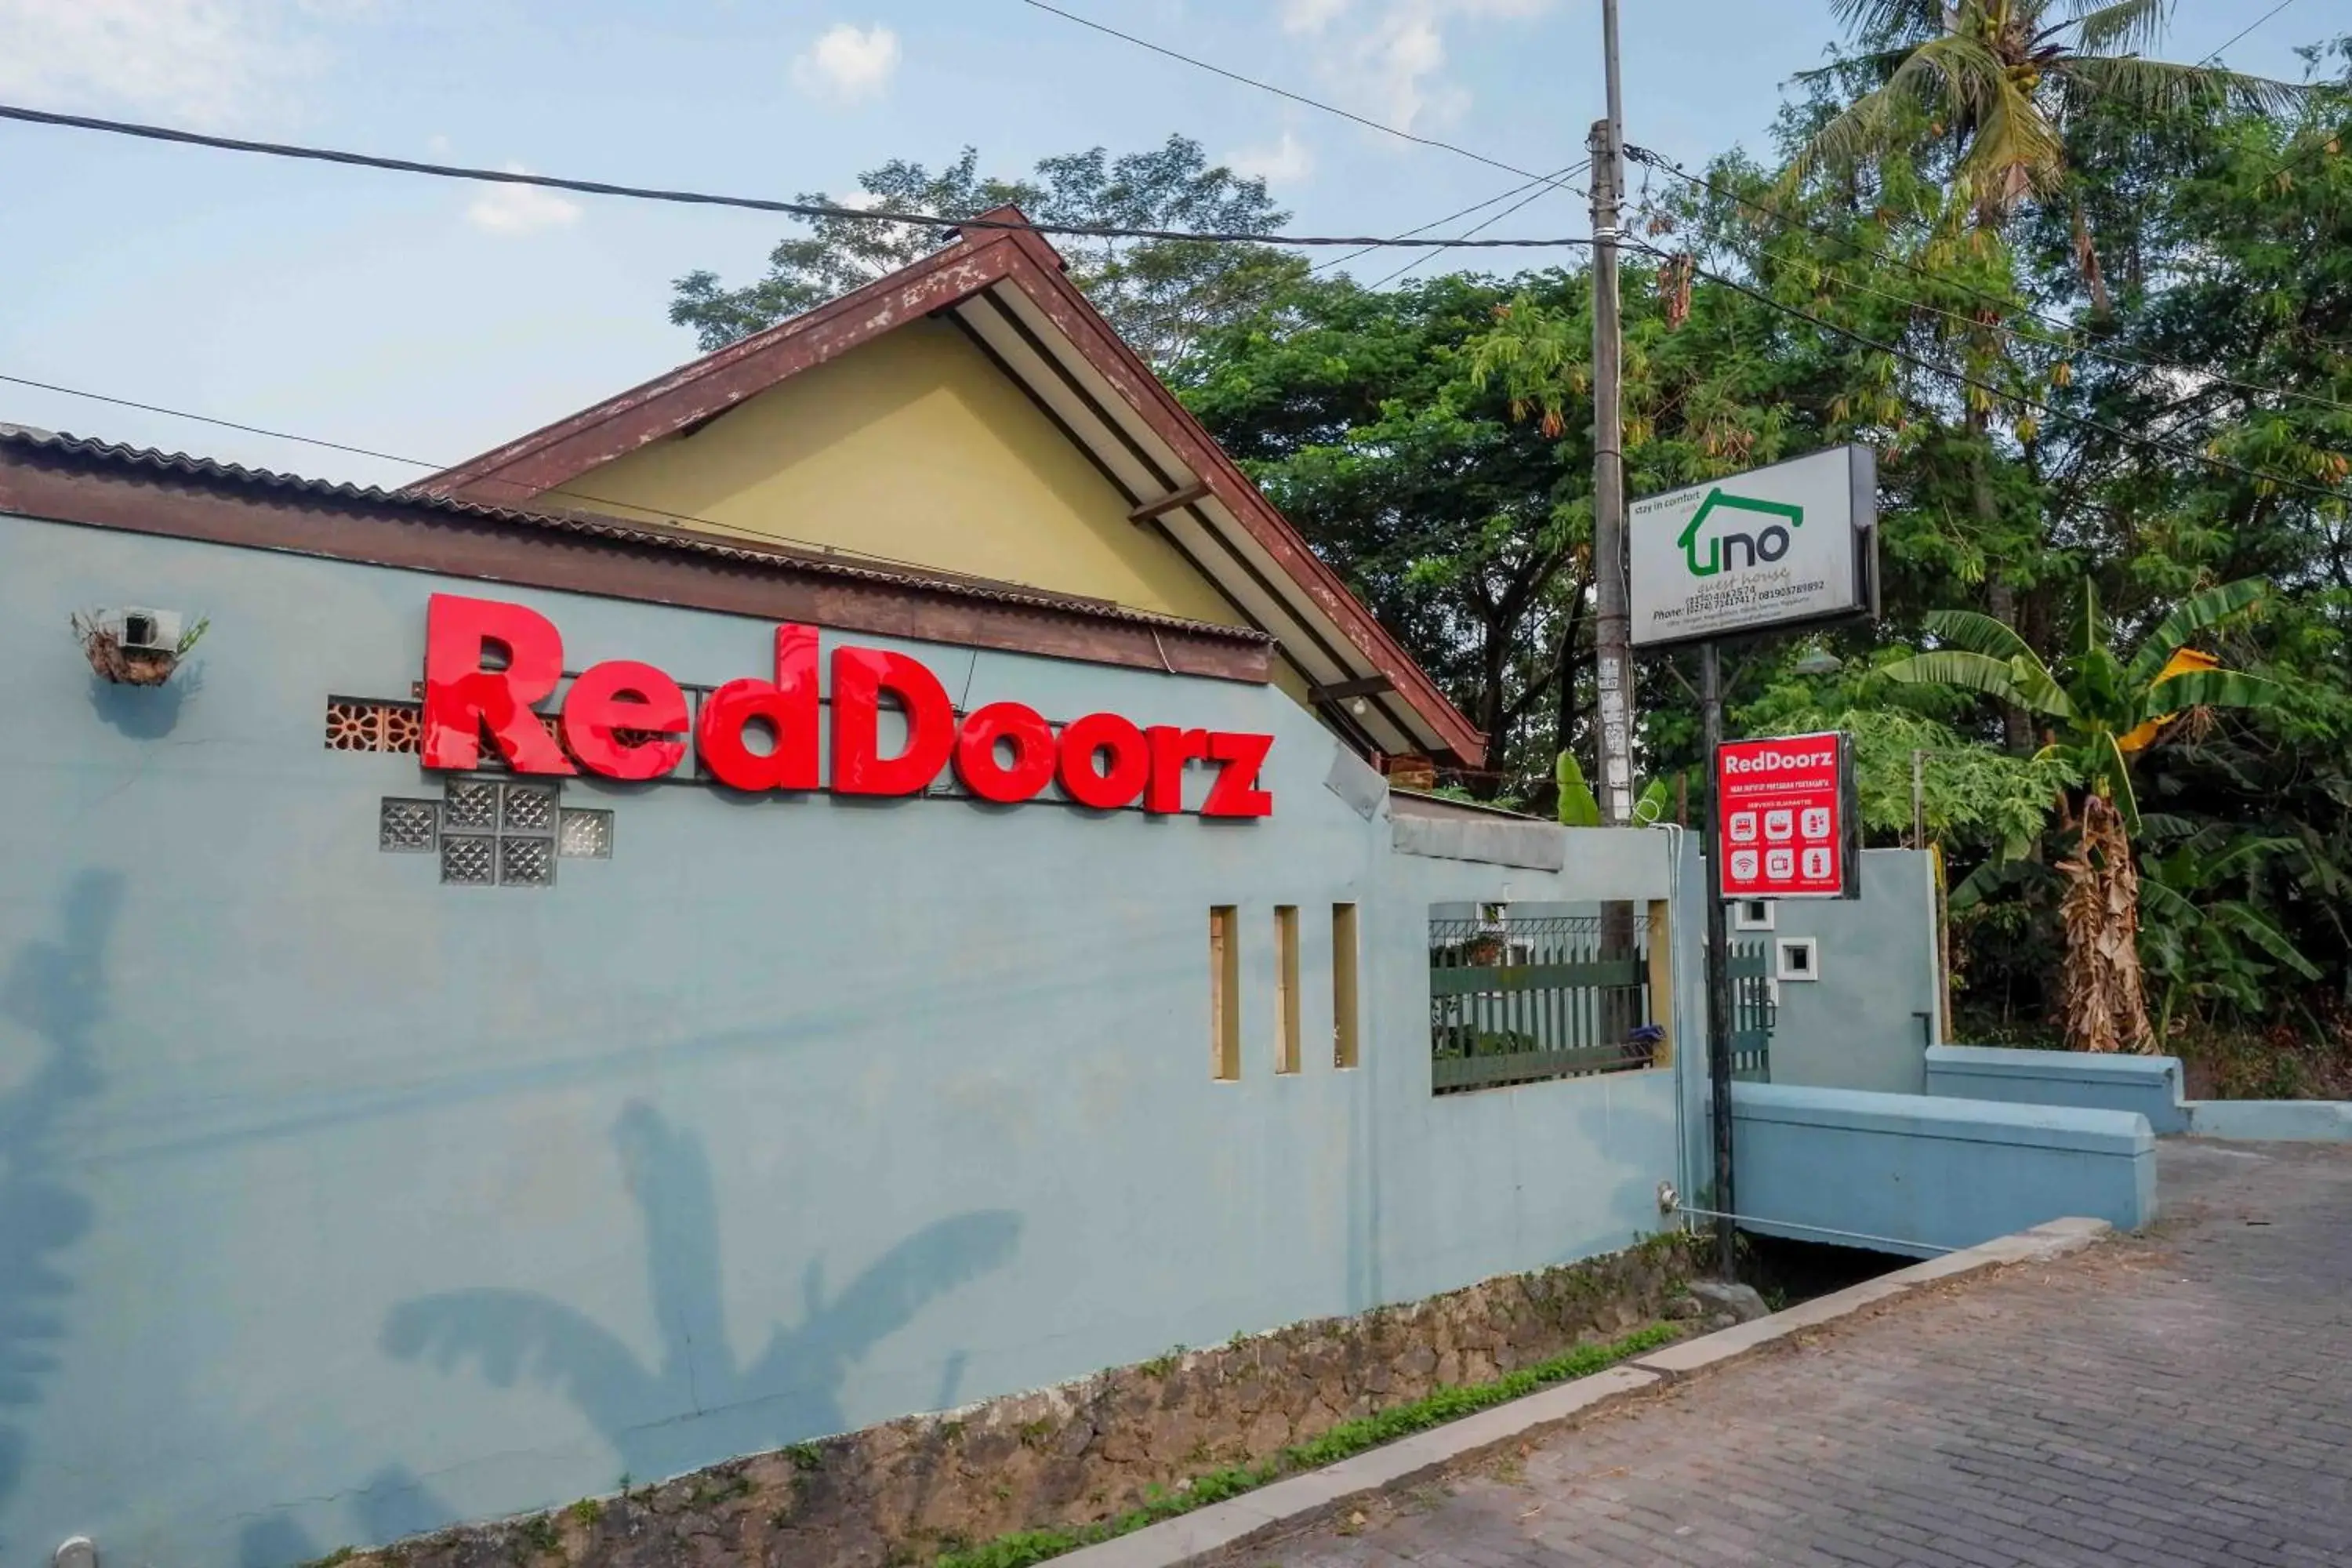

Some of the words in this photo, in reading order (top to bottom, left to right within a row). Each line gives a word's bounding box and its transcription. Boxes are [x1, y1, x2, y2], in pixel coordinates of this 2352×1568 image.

[1635, 506, 1652, 515] stay
[1653, 501, 1663, 510] in
[1664, 492, 1700, 507] comfort
[1686, 524, 1790, 576] uno
[1741, 567, 1790, 586] house
[1653, 607, 1685, 620] Phone:
[421, 591, 1276, 818] RedDoorz
[1725, 750, 1833, 775] RedDoorz
